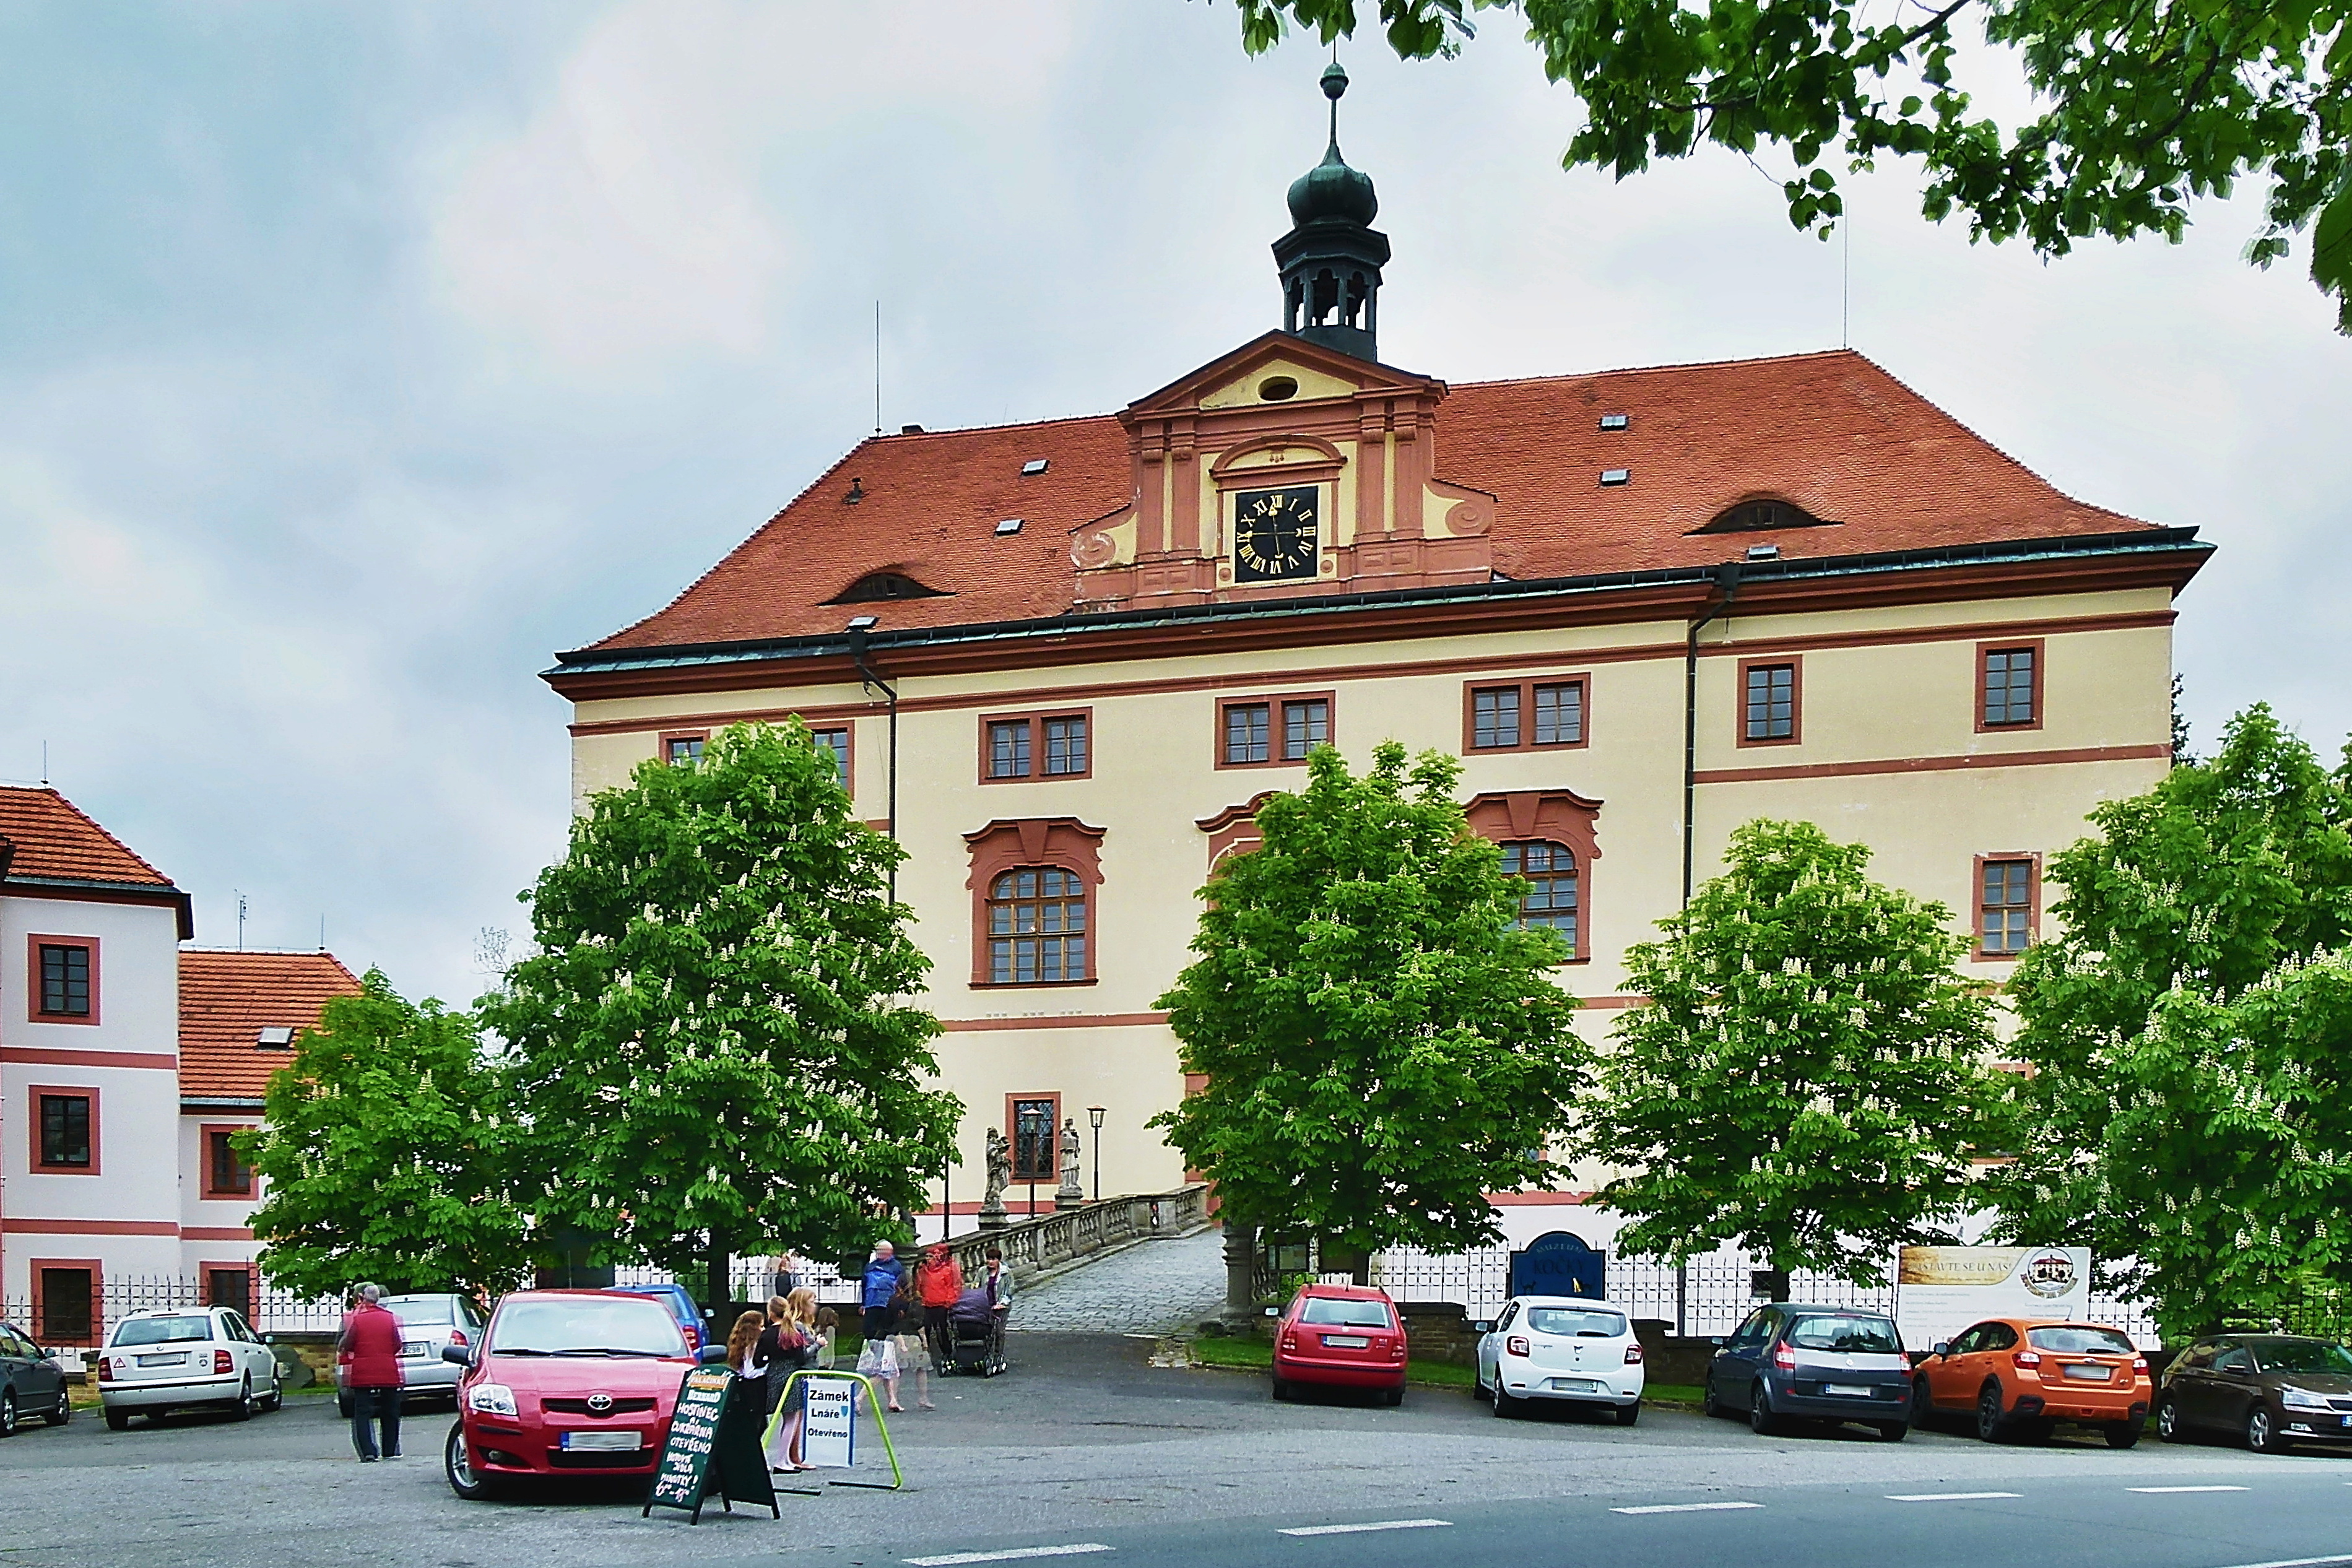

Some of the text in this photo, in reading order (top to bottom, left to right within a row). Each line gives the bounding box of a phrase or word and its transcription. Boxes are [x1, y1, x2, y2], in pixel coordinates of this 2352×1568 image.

[1252, 499, 1268, 516] XI
[1270, 495, 1283, 508] XII
[1288, 498, 1299, 511] I
[1241, 514, 1256, 527] X
[1297, 509, 1313, 522] II
[1303, 526, 1316, 537] III
[1238, 544, 1256, 563] VIII
[1298, 540, 1313, 557] IV
[1249, 555, 1266, 573] VII
[1270, 560, 1282, 574] VI
[1288, 555, 1300, 570] V
[1536, 1242, 1582, 1254] MUZEUM
[809, 1390, 849, 1401] Zámek
[811, 1408, 840, 1419] Lnáře
[807, 1427, 848, 1438] Otevřeno
